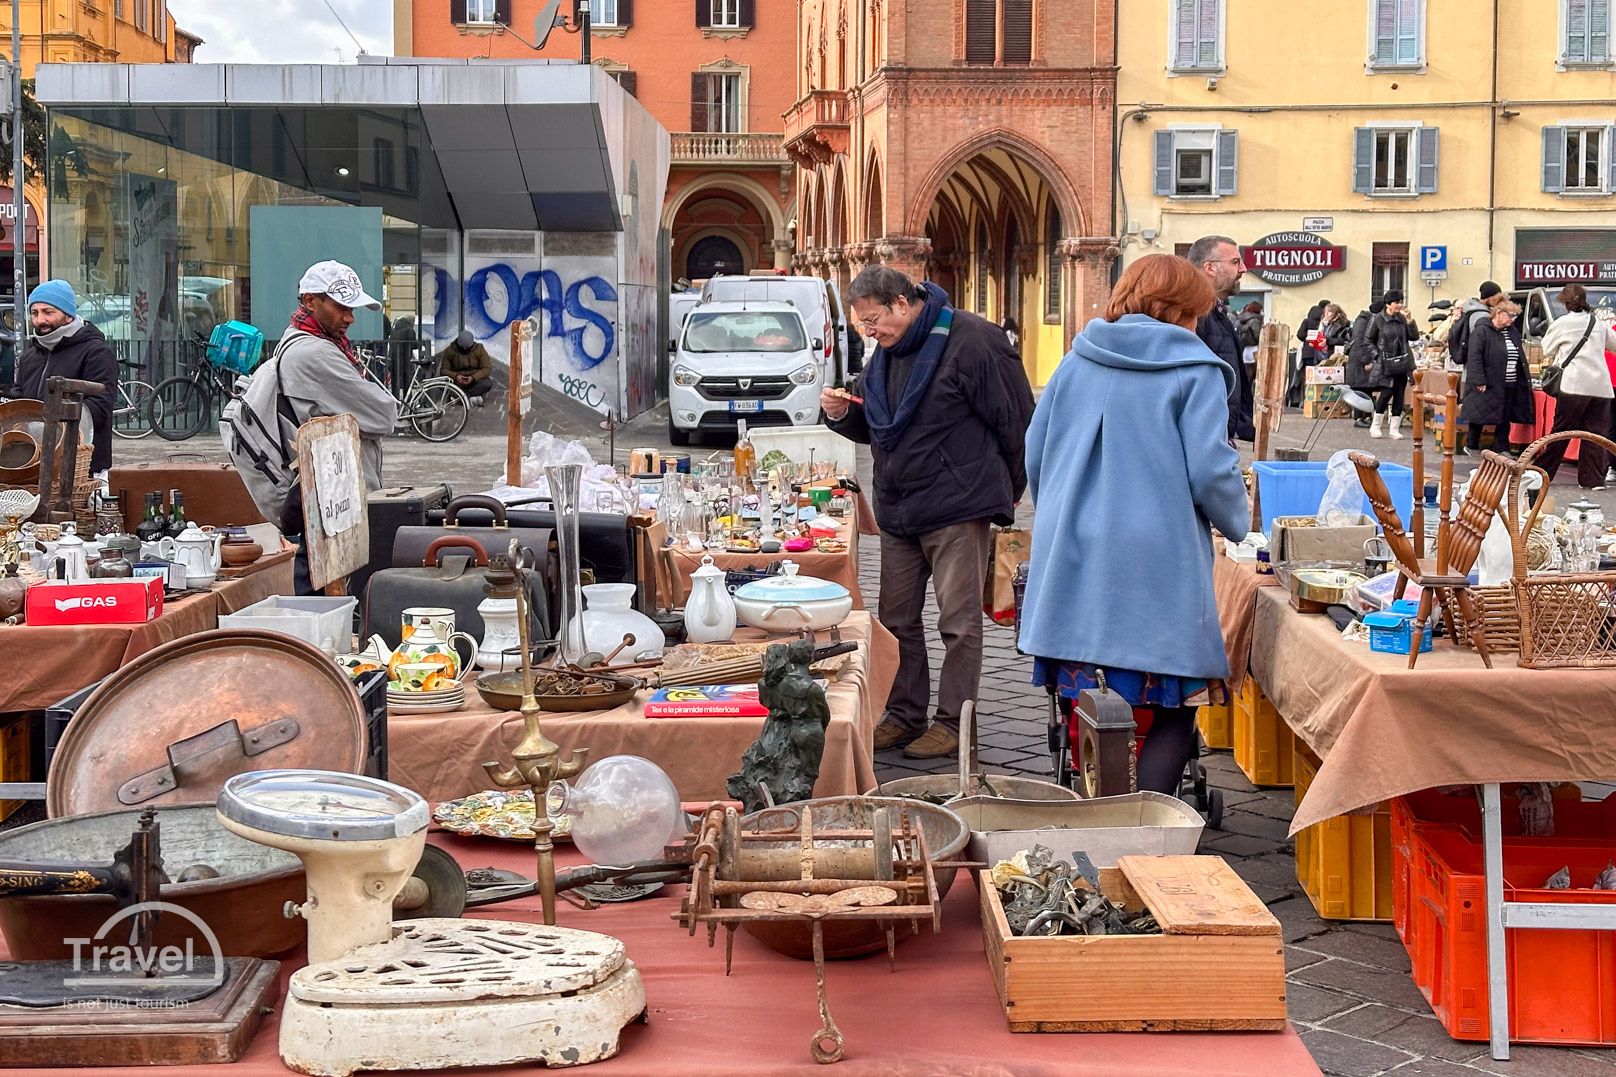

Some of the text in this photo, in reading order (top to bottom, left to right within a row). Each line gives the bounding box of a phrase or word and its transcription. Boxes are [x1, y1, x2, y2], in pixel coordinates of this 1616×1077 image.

[0, 203, 30, 219] POT
[1265, 233, 1321, 245] AUTOSCUOLA
[1253, 249, 1333, 266] TUGNOLI
[1425, 248, 1442, 268] P
[1522, 263, 1595, 279] TUGNOLI
[1602, 263, 1616, 271] AUT
[1262, 270, 1323, 283] PRATICHE AUTO
[80, 596, 117, 608] GAS
[675, 705, 704, 715] piramide
[704, 705, 740, 713] misteriosa
